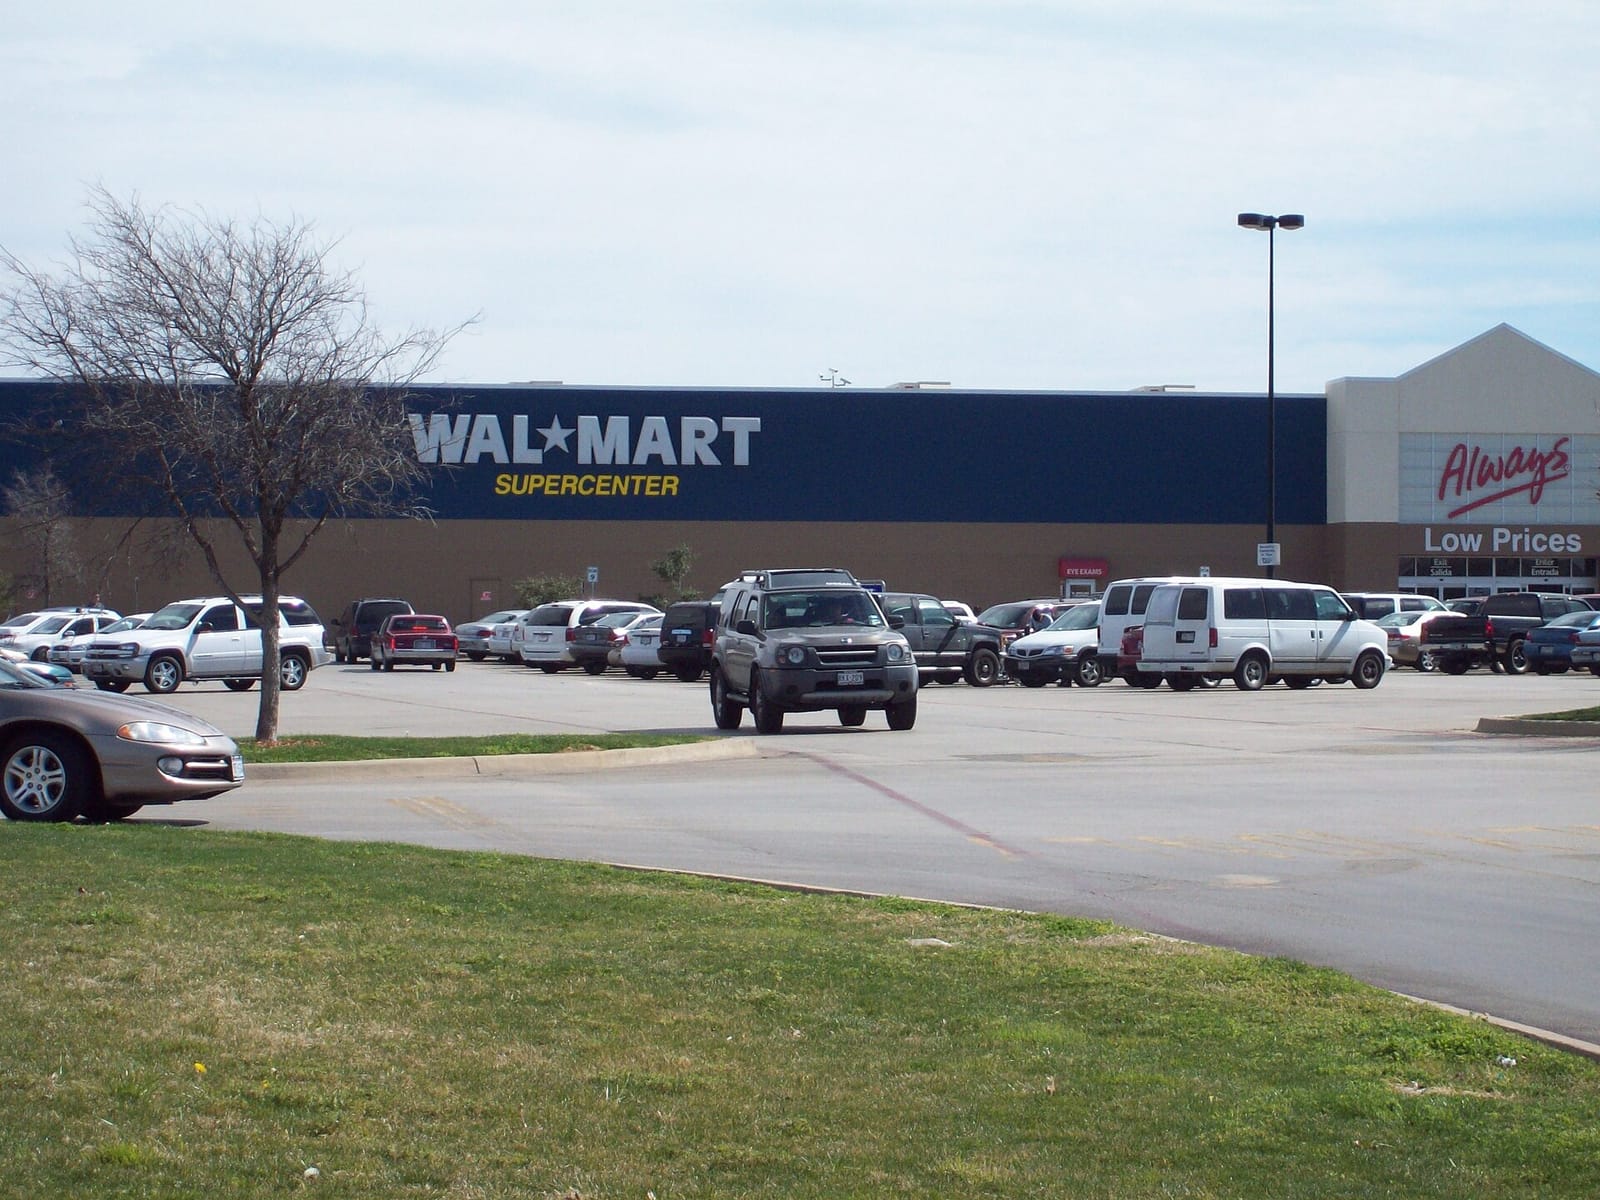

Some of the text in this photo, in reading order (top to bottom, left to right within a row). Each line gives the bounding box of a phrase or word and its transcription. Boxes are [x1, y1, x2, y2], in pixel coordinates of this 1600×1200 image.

[1438, 437, 1569, 506] Always
[495, 473, 680, 496] SUPERCENTER
[1424, 527, 1582, 553] Low Prices
[1430, 568, 1452, 577] Salida
[1531, 568, 1559, 577] Entrada
